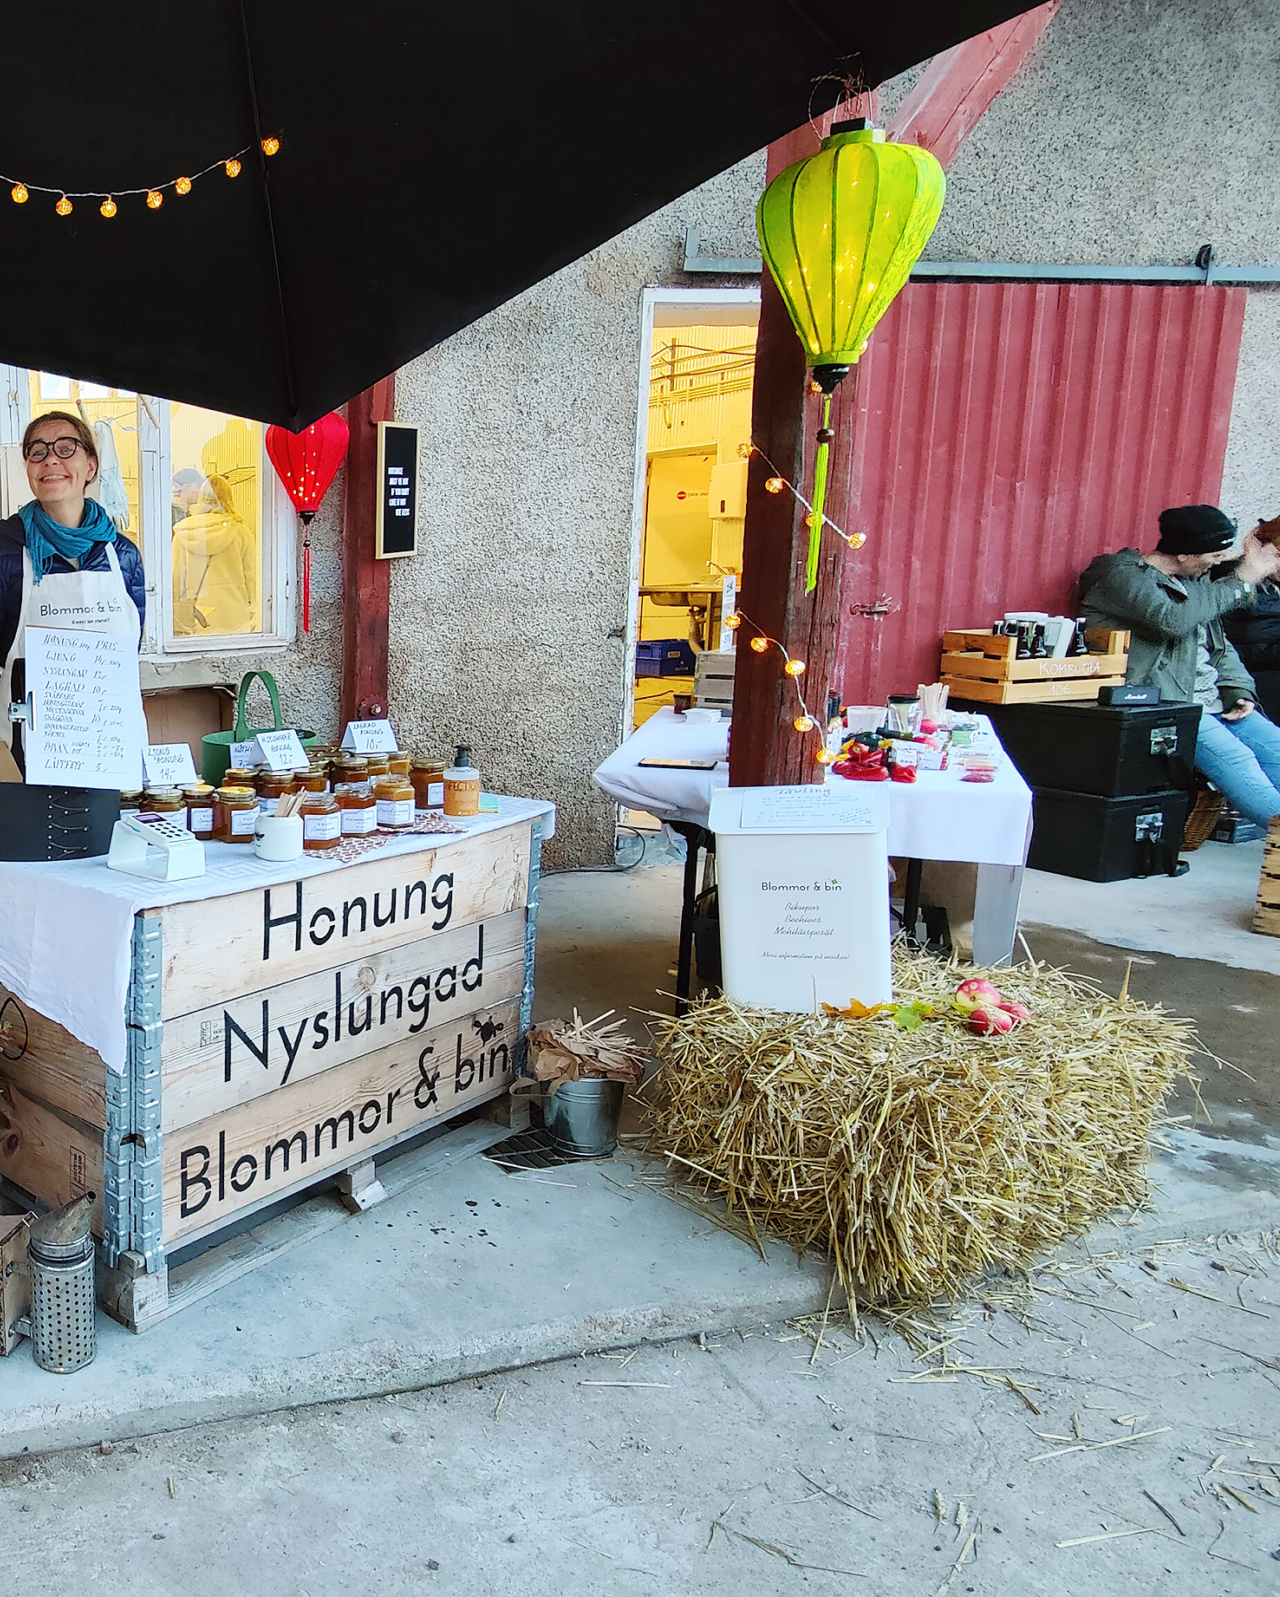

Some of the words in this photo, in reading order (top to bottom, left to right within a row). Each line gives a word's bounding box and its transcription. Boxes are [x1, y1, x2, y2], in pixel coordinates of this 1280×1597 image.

[40, 604, 94, 616] Blommor
[97, 602, 105, 612] &
[107, 600, 122, 612] bin
[1039, 661, 1100, 676] KOMBUCHA
[762, 881, 810, 891] Blommor
[814, 882, 821, 891] &
[824, 881, 842, 891] bin
[784, 902, 820, 913] Bikupor
[262, 872, 454, 961] Honung
[224, 924, 484, 1086] Nyslungad
[180, 1085, 402, 1219] Blommor
[414, 1046, 440, 1110] &
[455, 1032, 508, 1094] bin
